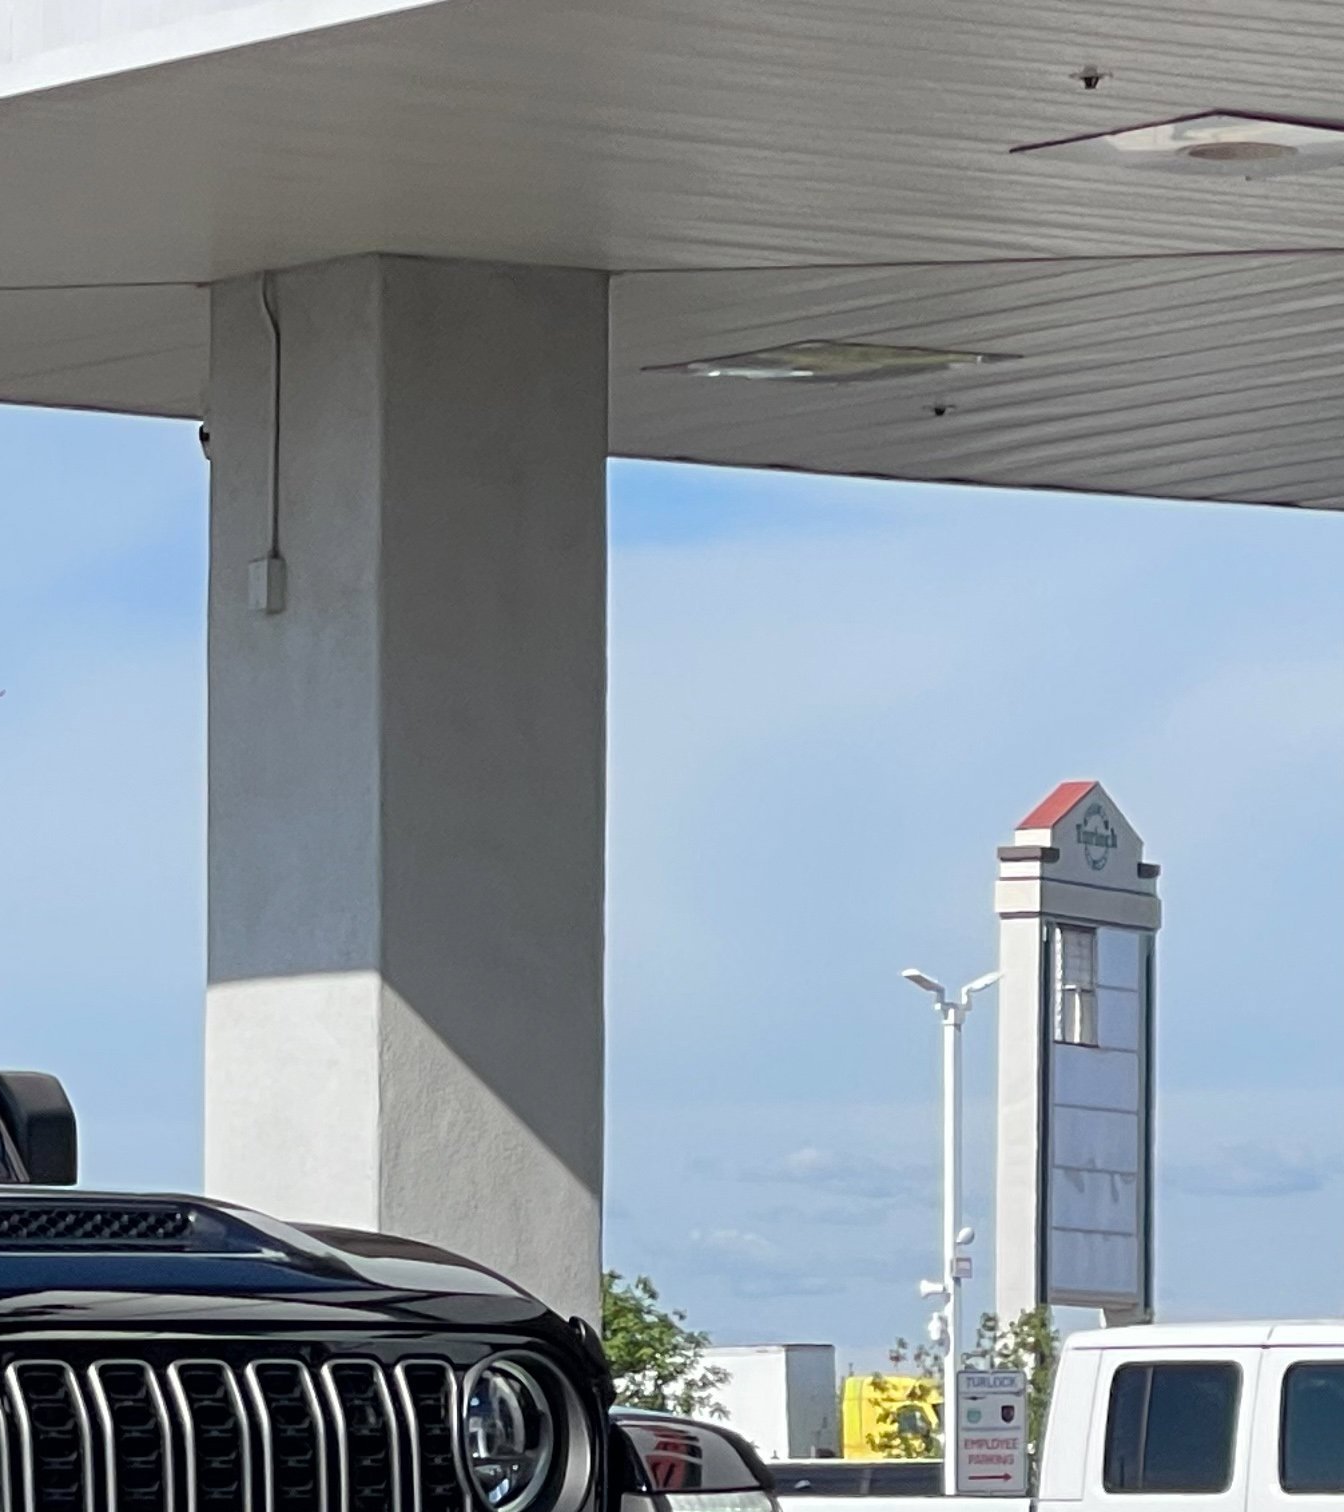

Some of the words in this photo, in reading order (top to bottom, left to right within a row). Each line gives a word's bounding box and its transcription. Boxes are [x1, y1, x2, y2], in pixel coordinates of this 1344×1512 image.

[966, 1376, 1017, 1388] TURLOCK
[964, 1438, 1018, 1450] EMPLOYEE
[968, 1454, 1015, 1465] PARKING
